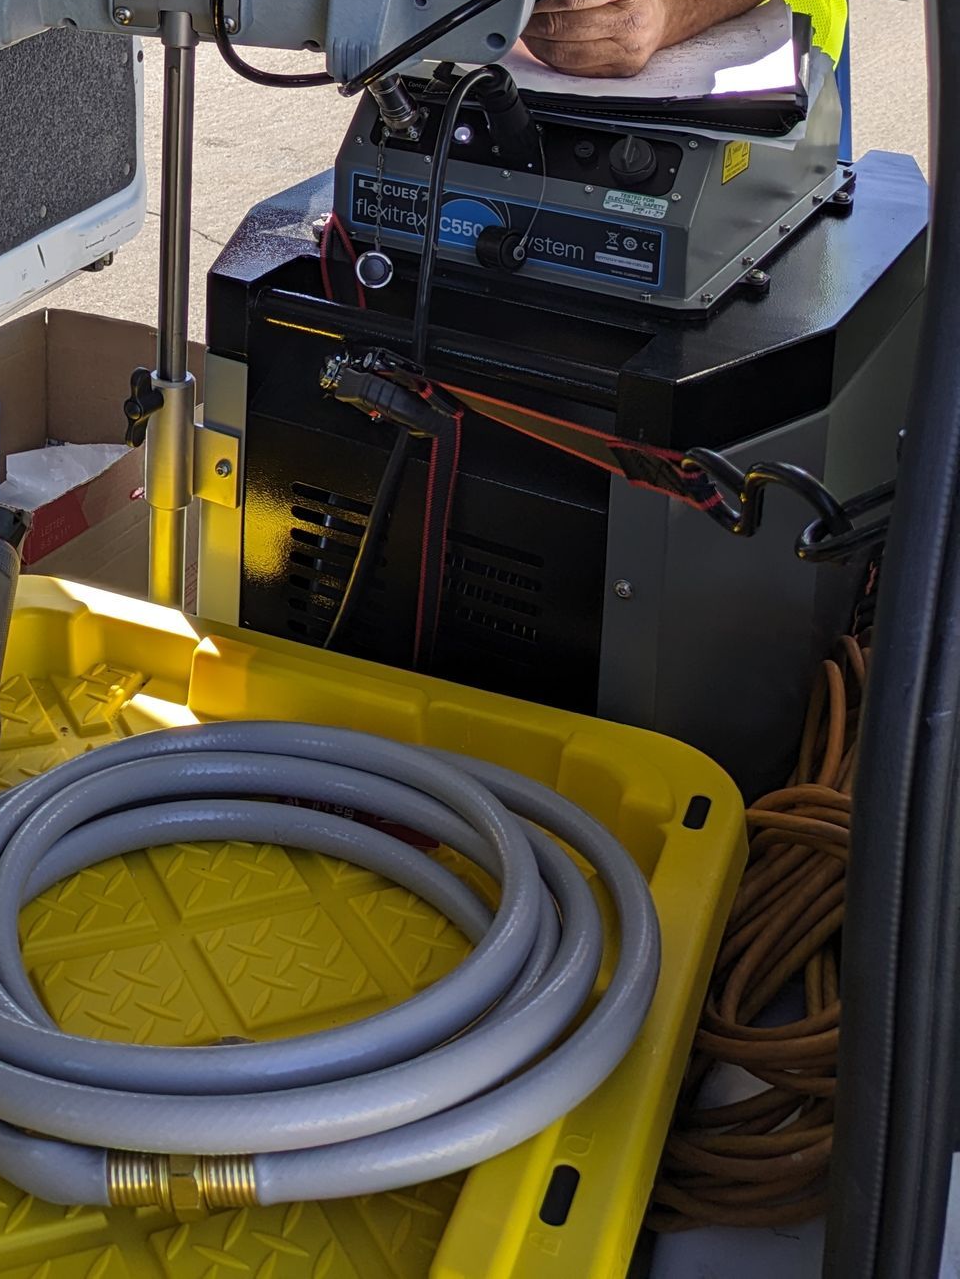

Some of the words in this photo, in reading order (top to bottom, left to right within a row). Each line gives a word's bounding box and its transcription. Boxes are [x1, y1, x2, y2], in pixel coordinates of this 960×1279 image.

[382, 184, 418, 200] CUES
[620, 192, 642, 201] TESTED
[607, 195, 642, 206] ELECTRICAL
[642, 201, 665, 211] SAFETY
[355, 198, 427, 227] flexitrax
